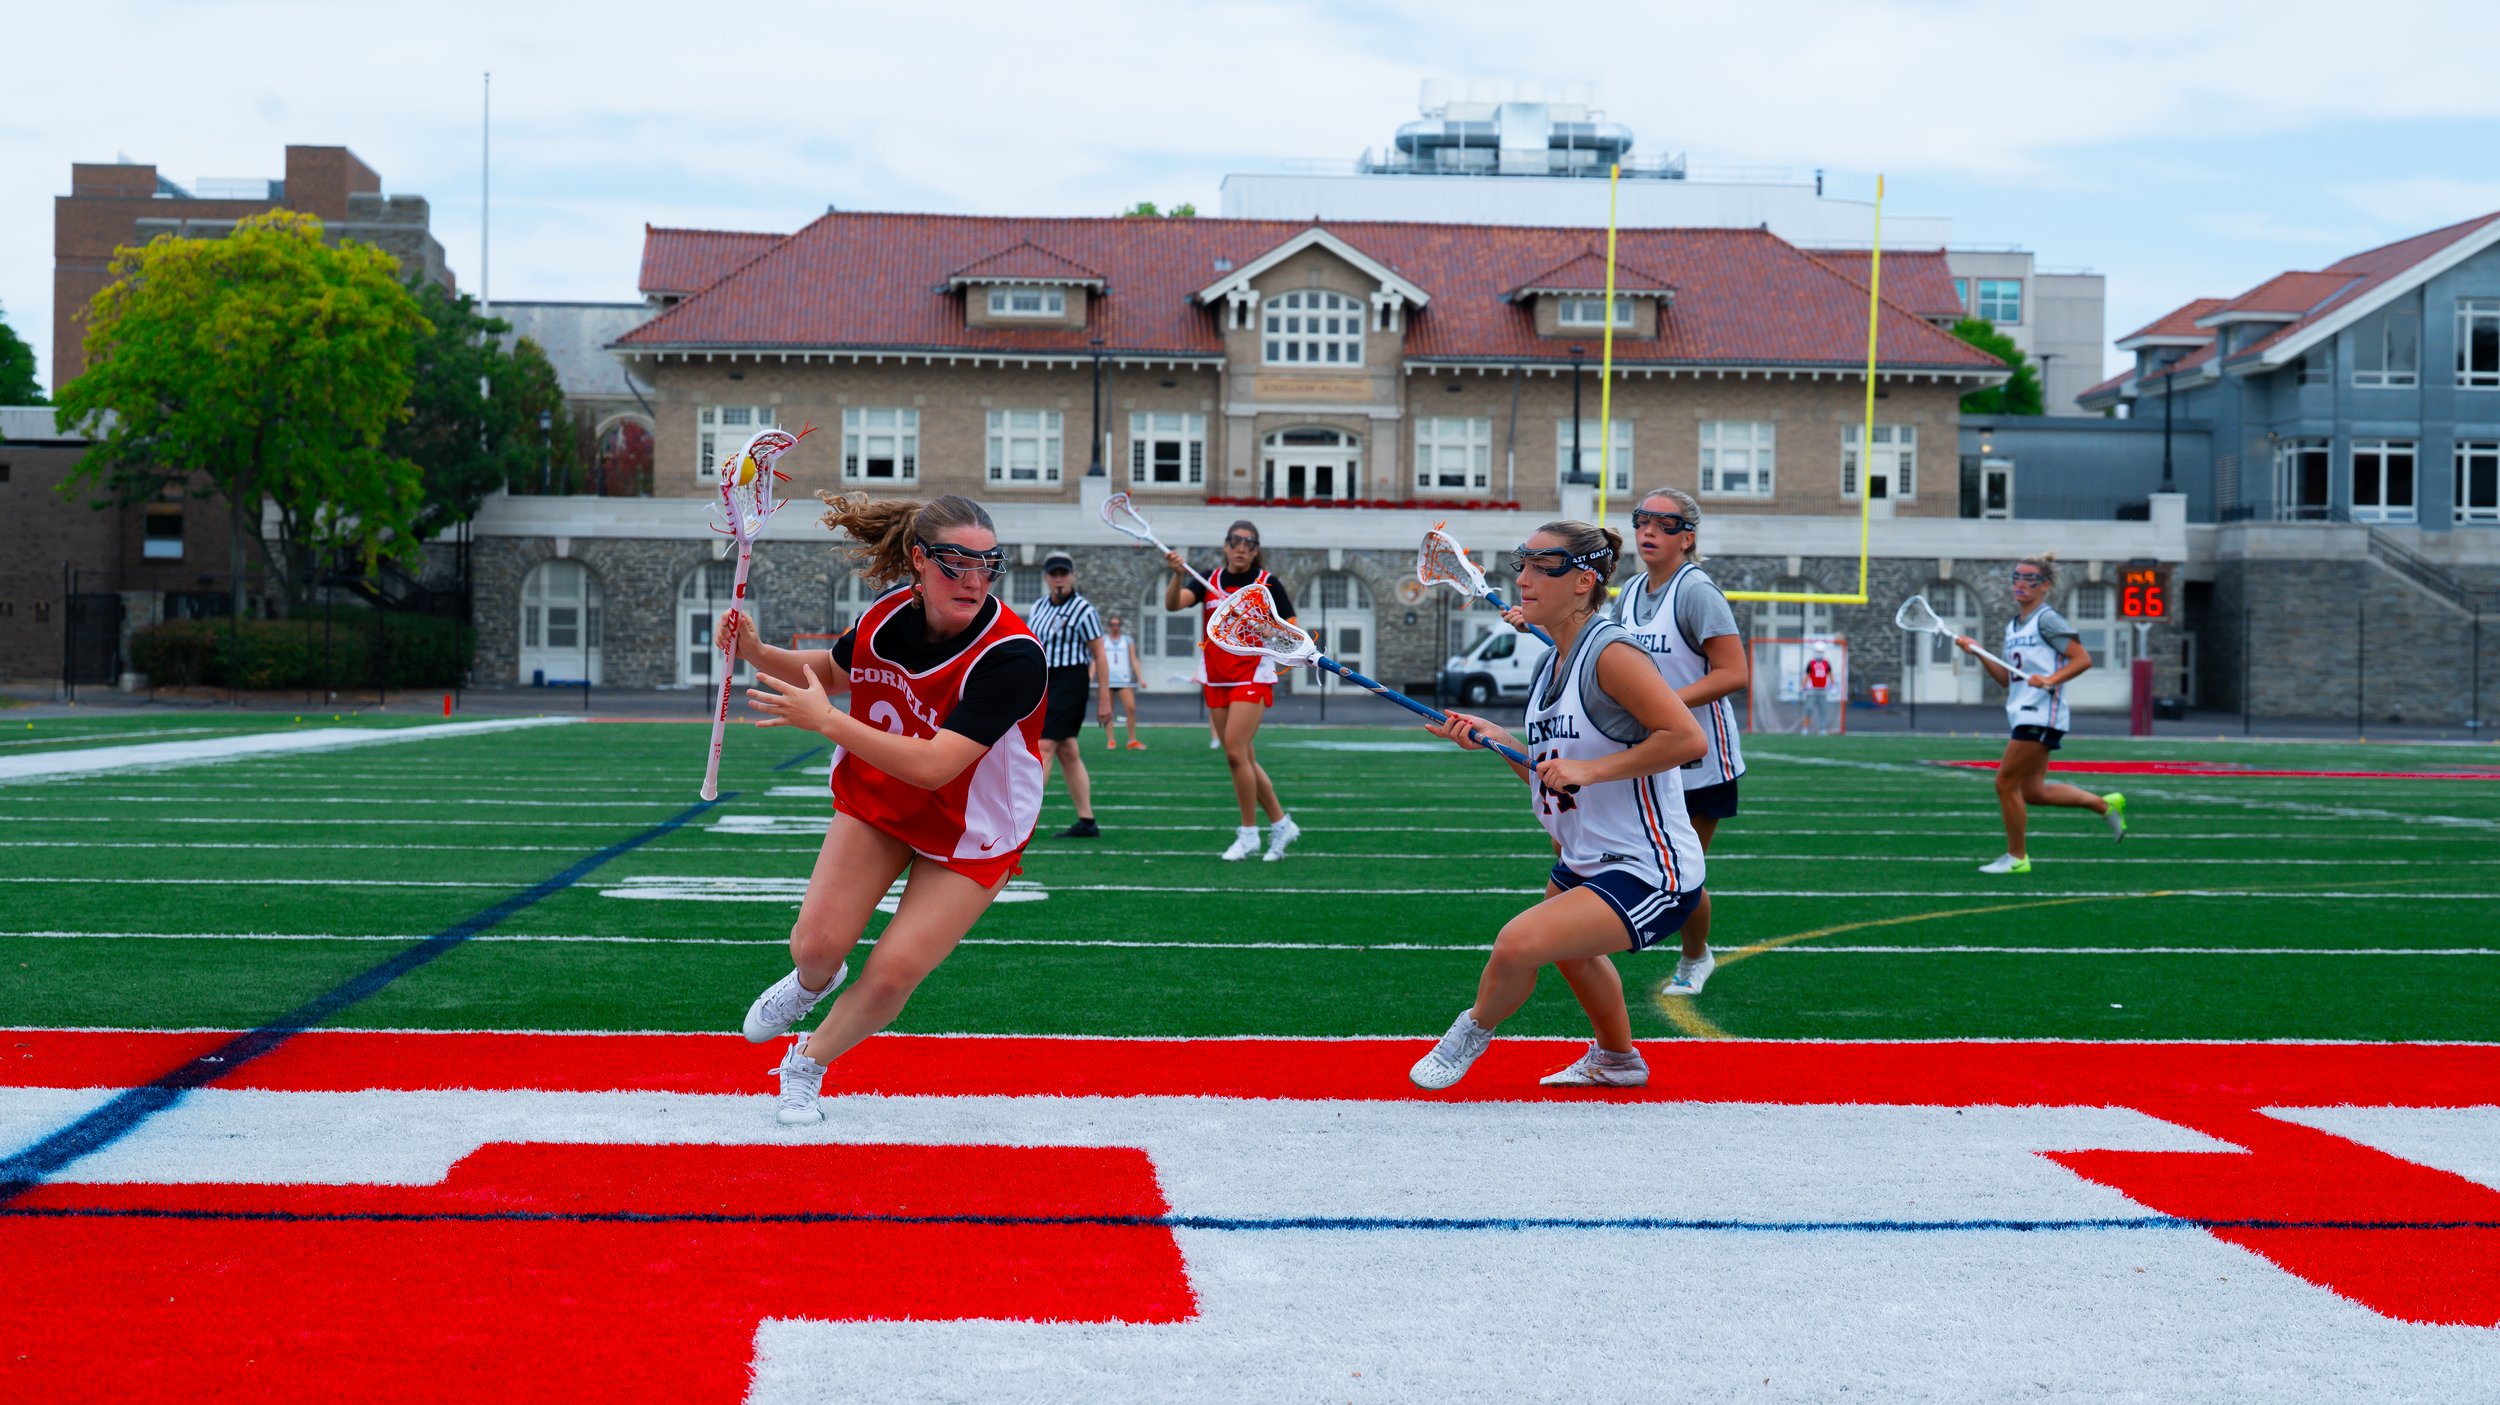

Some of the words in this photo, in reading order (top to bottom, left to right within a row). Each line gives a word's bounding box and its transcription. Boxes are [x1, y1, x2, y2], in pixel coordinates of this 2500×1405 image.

[1589, 548, 1608, 560] GAIT
[2123, 586, 2164, 618] 66
[849, 666, 942, 733] CORNELL
